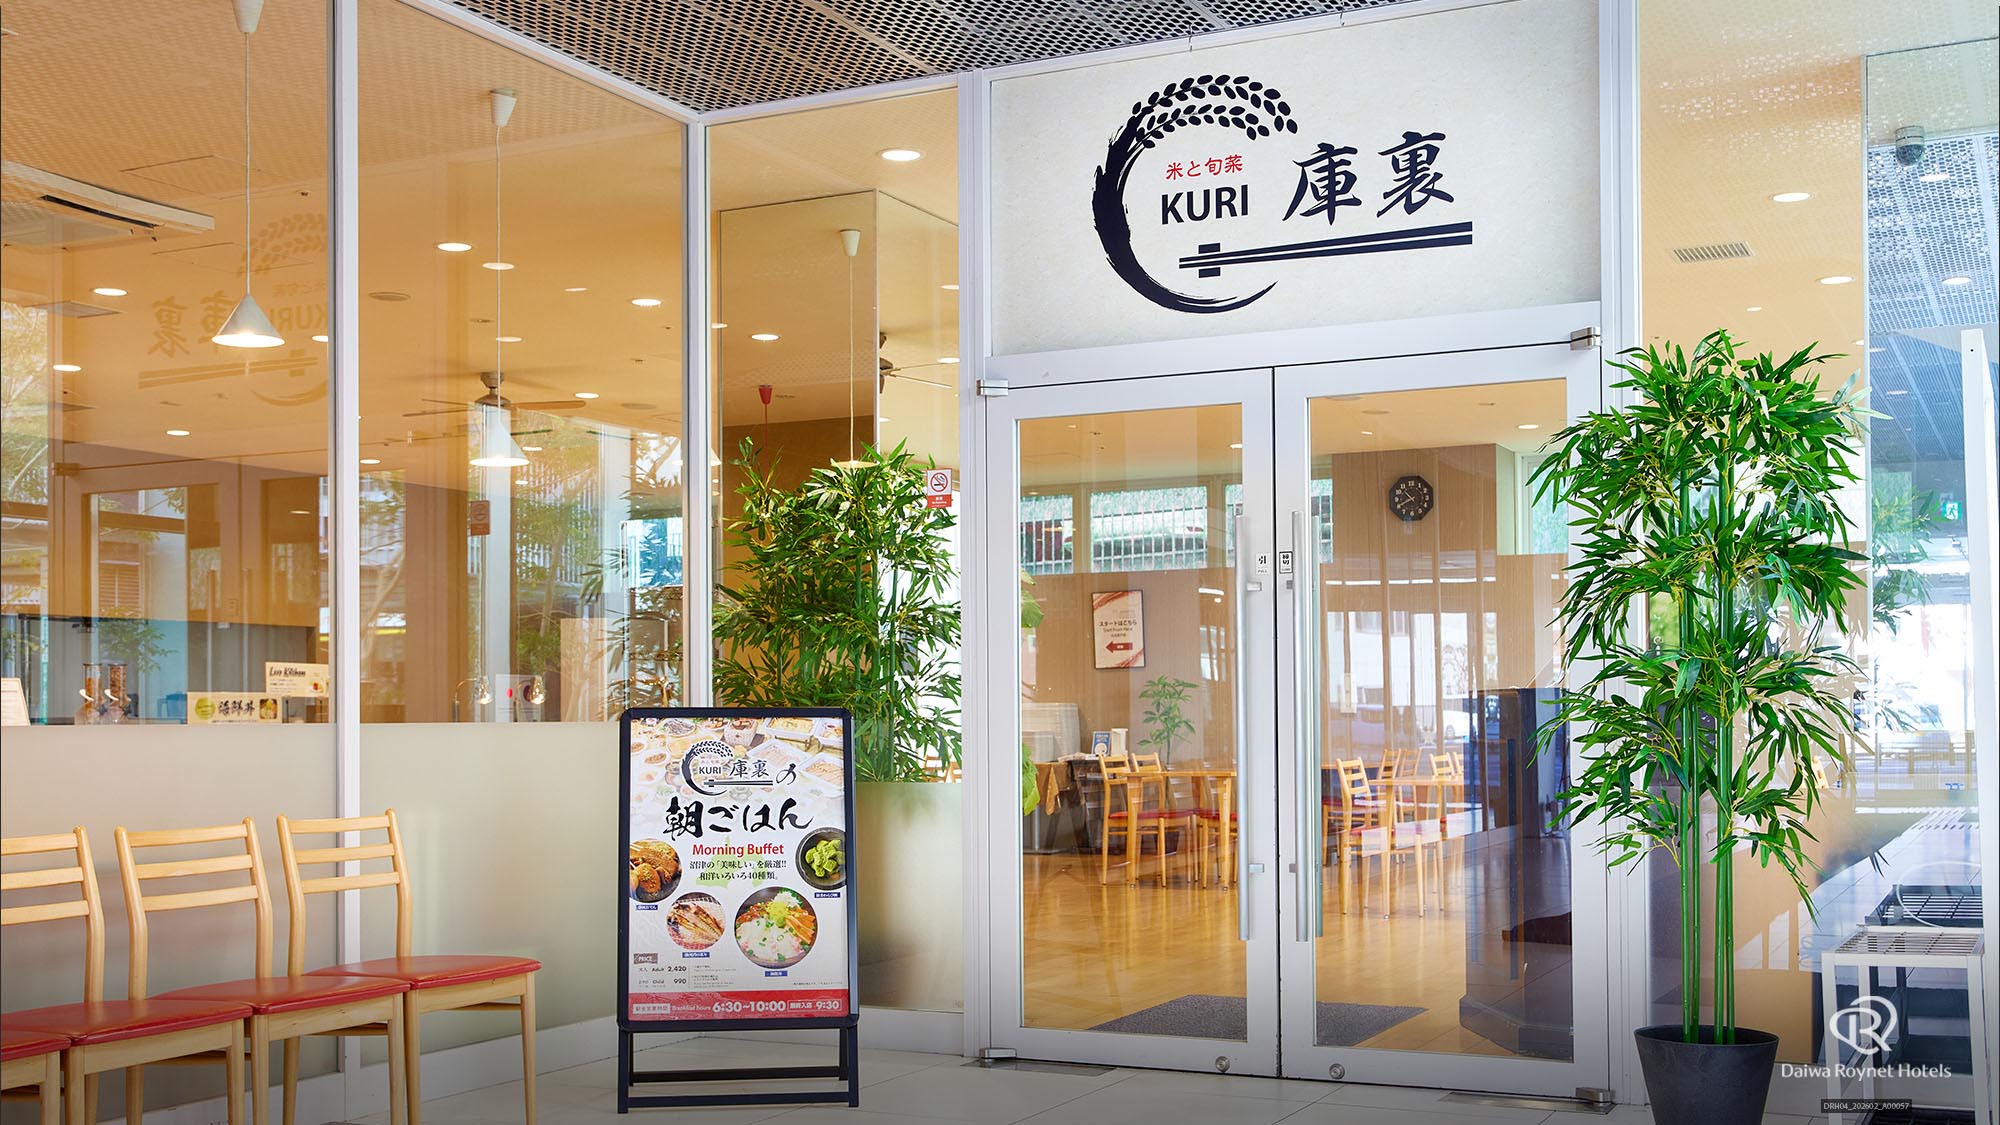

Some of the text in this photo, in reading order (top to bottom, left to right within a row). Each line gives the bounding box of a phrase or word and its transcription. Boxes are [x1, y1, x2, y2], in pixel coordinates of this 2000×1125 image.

[1165, 154, 1243, 181] 米と旬菜
[1282, 131, 1455, 226] 庫裏
[1161, 184, 1249, 225] KURI
[699, 760, 797, 786] KURI 庫裏 の
[663, 796, 814, 841] 朝ごはん
[692, 843, 785, 858] Morning Buffet
[816, 1001, 839, 1009] 9:30
